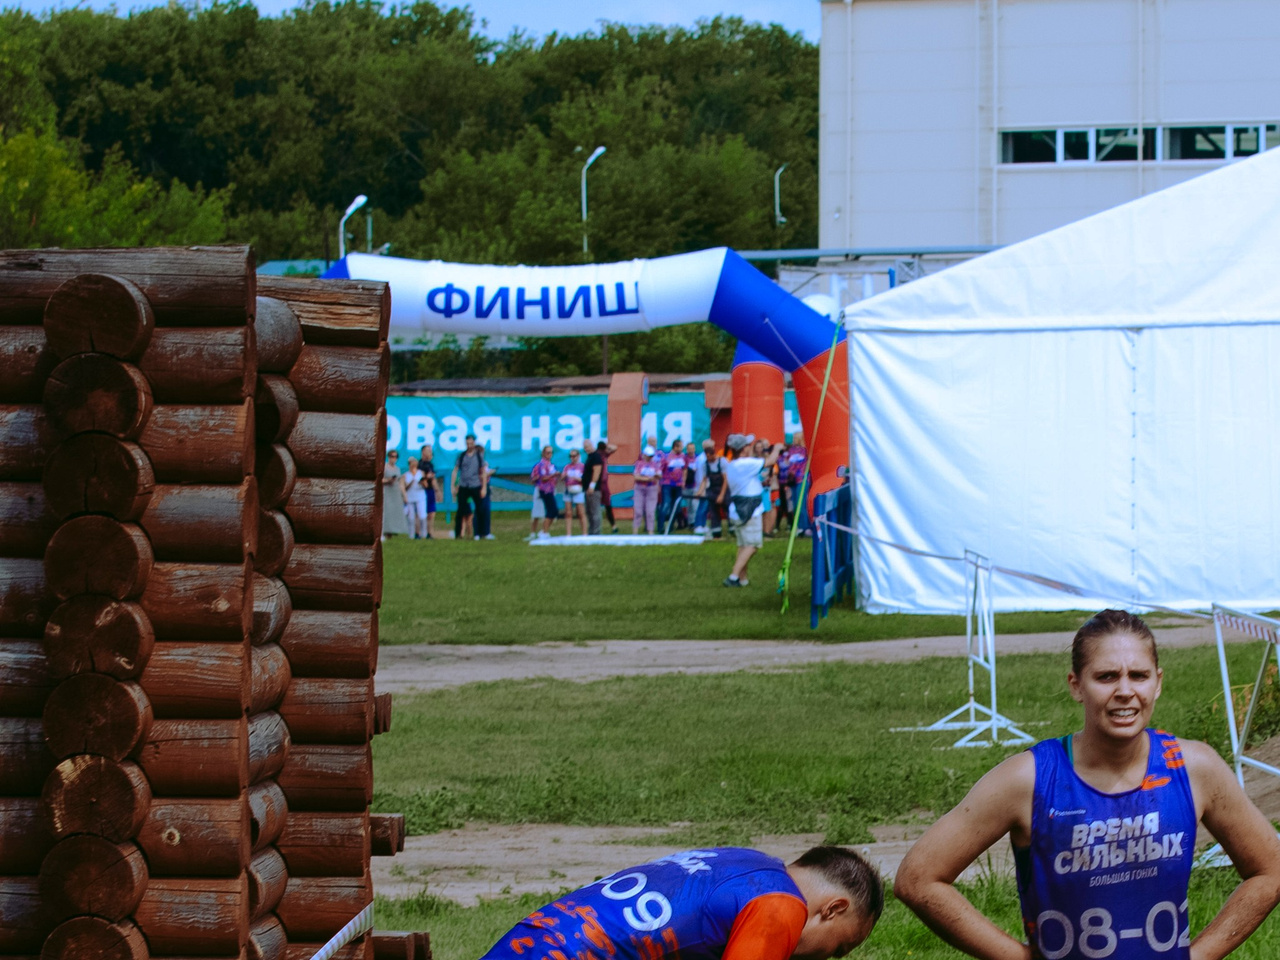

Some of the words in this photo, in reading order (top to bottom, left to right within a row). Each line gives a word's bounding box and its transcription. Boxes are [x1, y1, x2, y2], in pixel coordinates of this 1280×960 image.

[426, 281, 640, 319] ФИНИШ
[1070, 811, 1160, 849] ВРЕМЯ
[1054, 832, 1185, 875] СИЛЬНЫХ
[1089, 871, 1130, 888] БОЛЬШАЯ
[1131, 866, 1159, 882] ГОНКА
